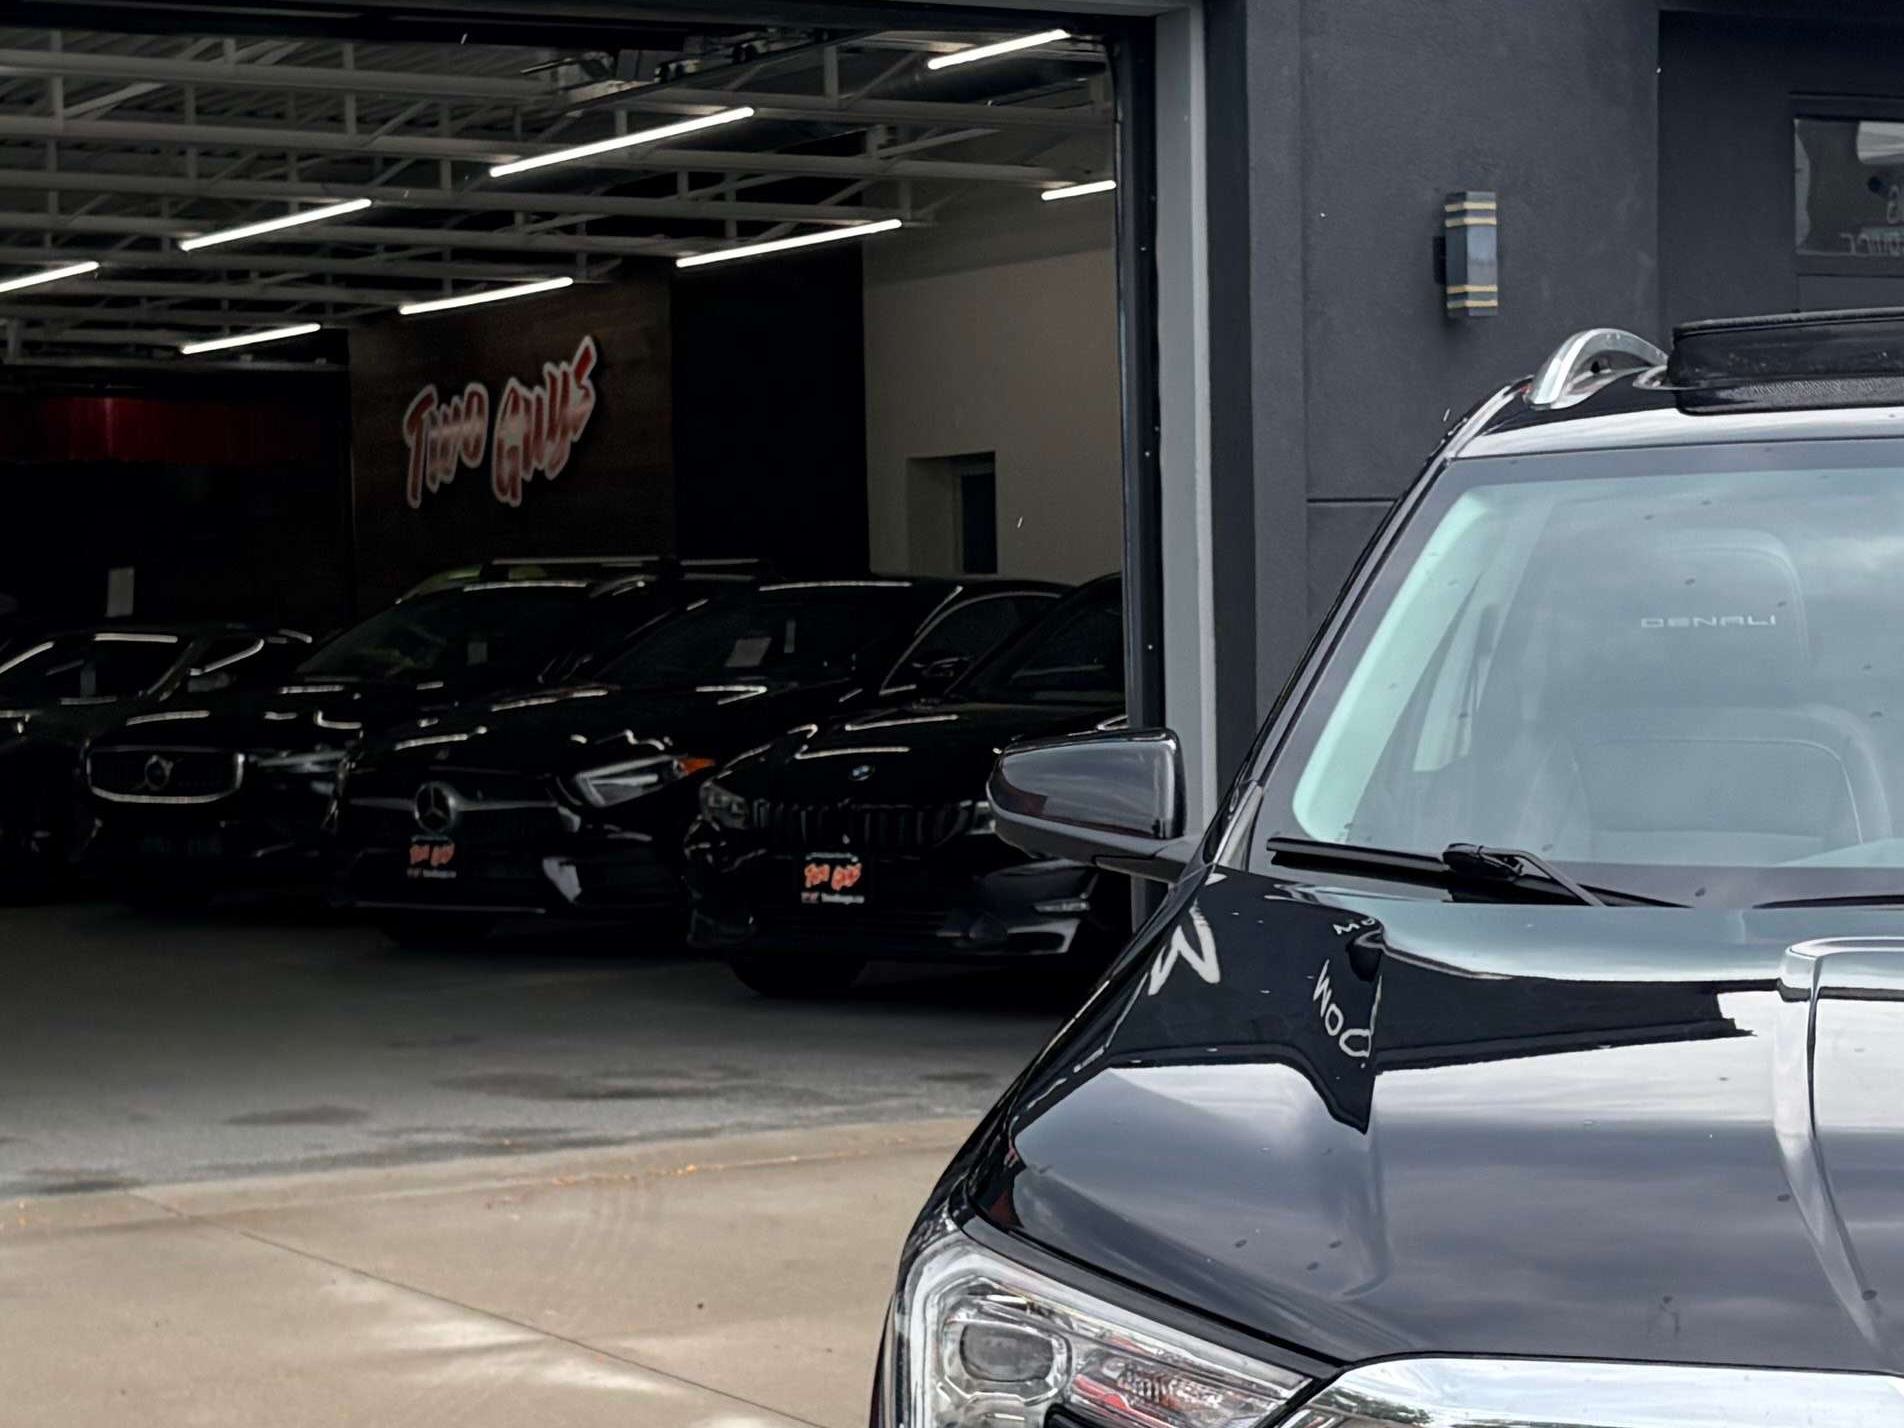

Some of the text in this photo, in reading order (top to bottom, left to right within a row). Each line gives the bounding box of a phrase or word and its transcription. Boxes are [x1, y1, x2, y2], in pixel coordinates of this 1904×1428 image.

[402, 334, 597, 508] Two Guys
[1641, 613, 1777, 628] DENALI
